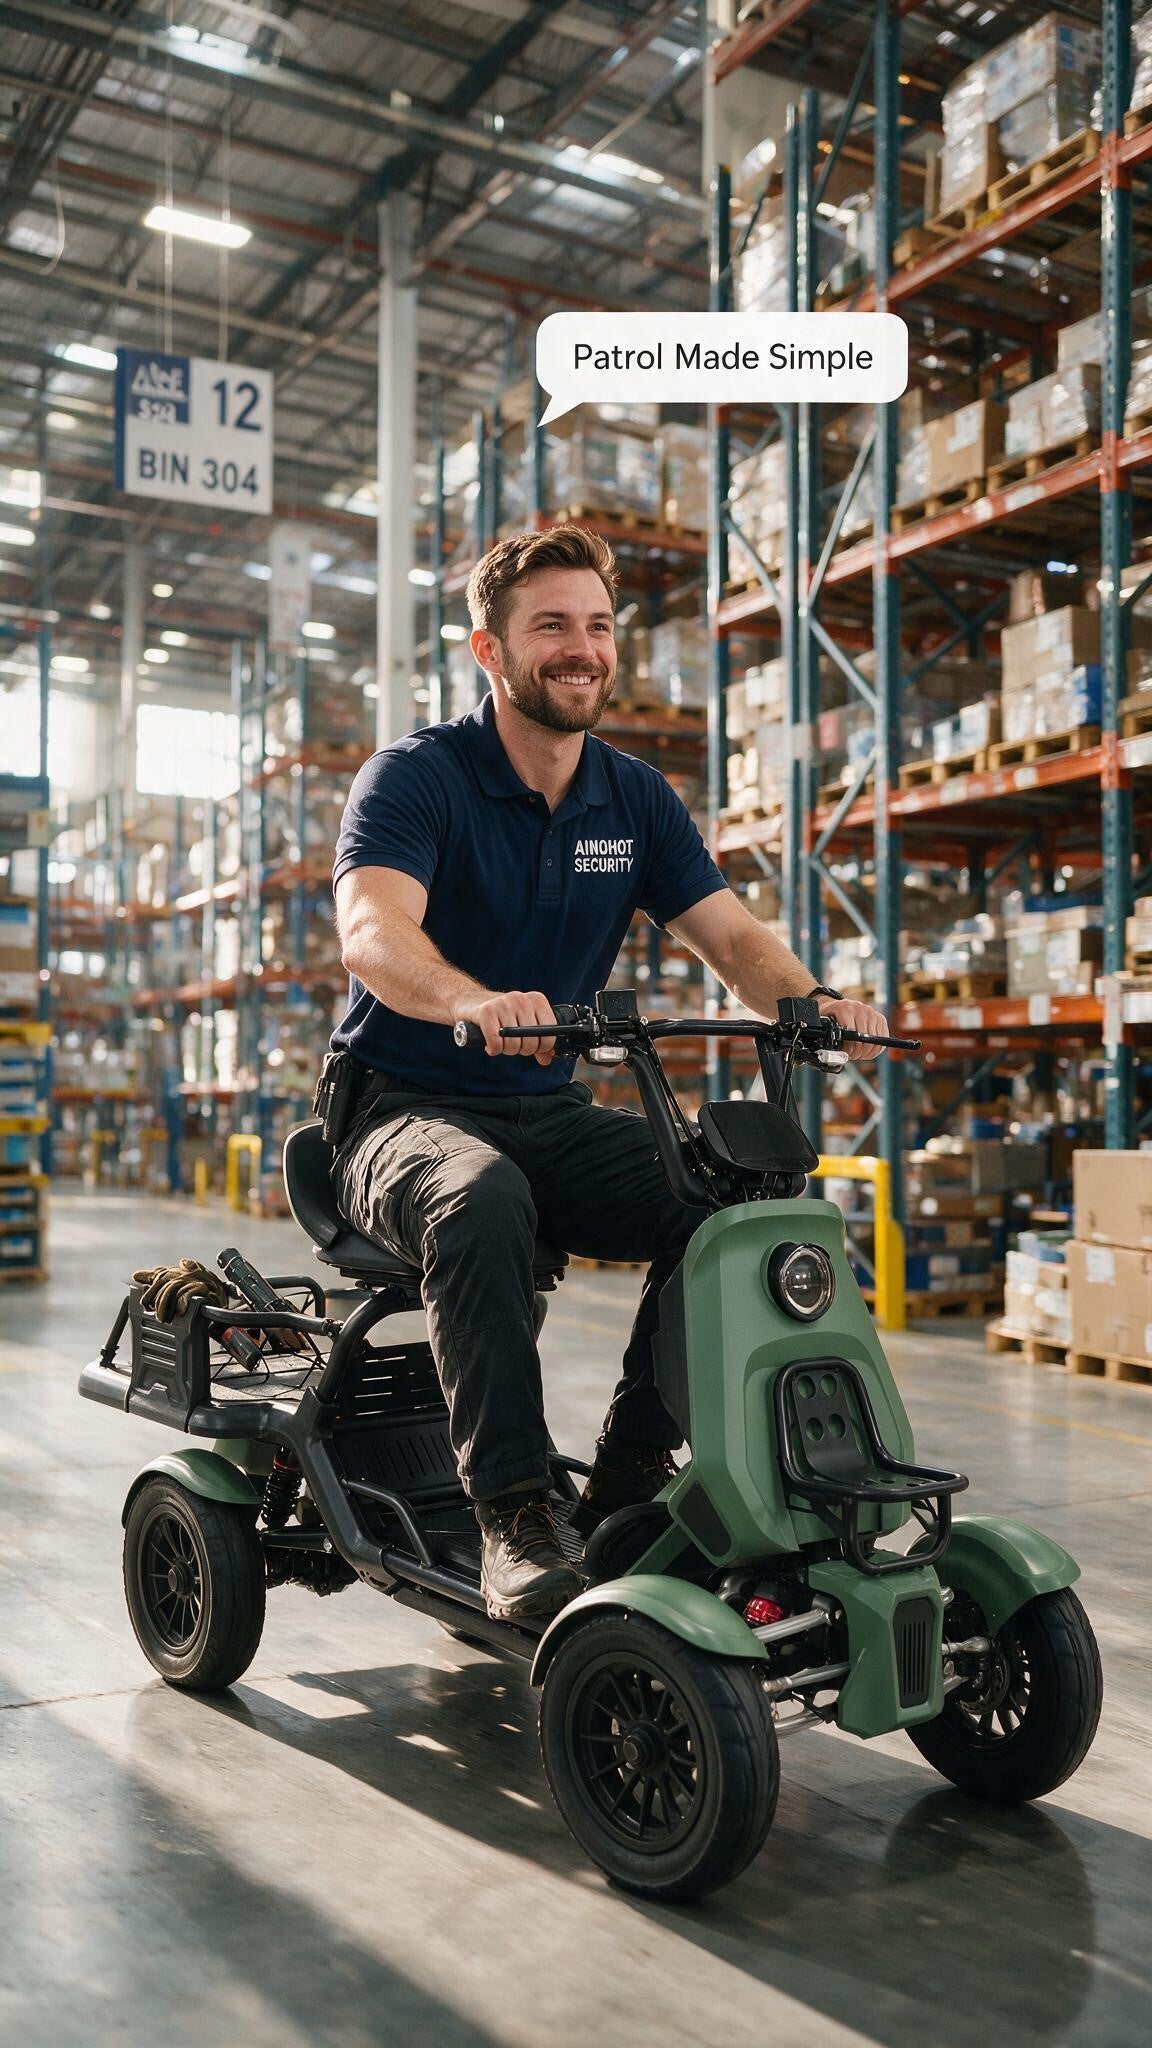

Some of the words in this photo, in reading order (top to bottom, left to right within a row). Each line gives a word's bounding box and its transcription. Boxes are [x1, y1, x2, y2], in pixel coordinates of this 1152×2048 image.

[212, 378, 262, 432] 12
[138, 447, 190, 485] BIN
[202, 458, 259, 497] 304
[574, 839, 634, 856] AINOHOT
[574, 857, 634, 873] SECURITY
